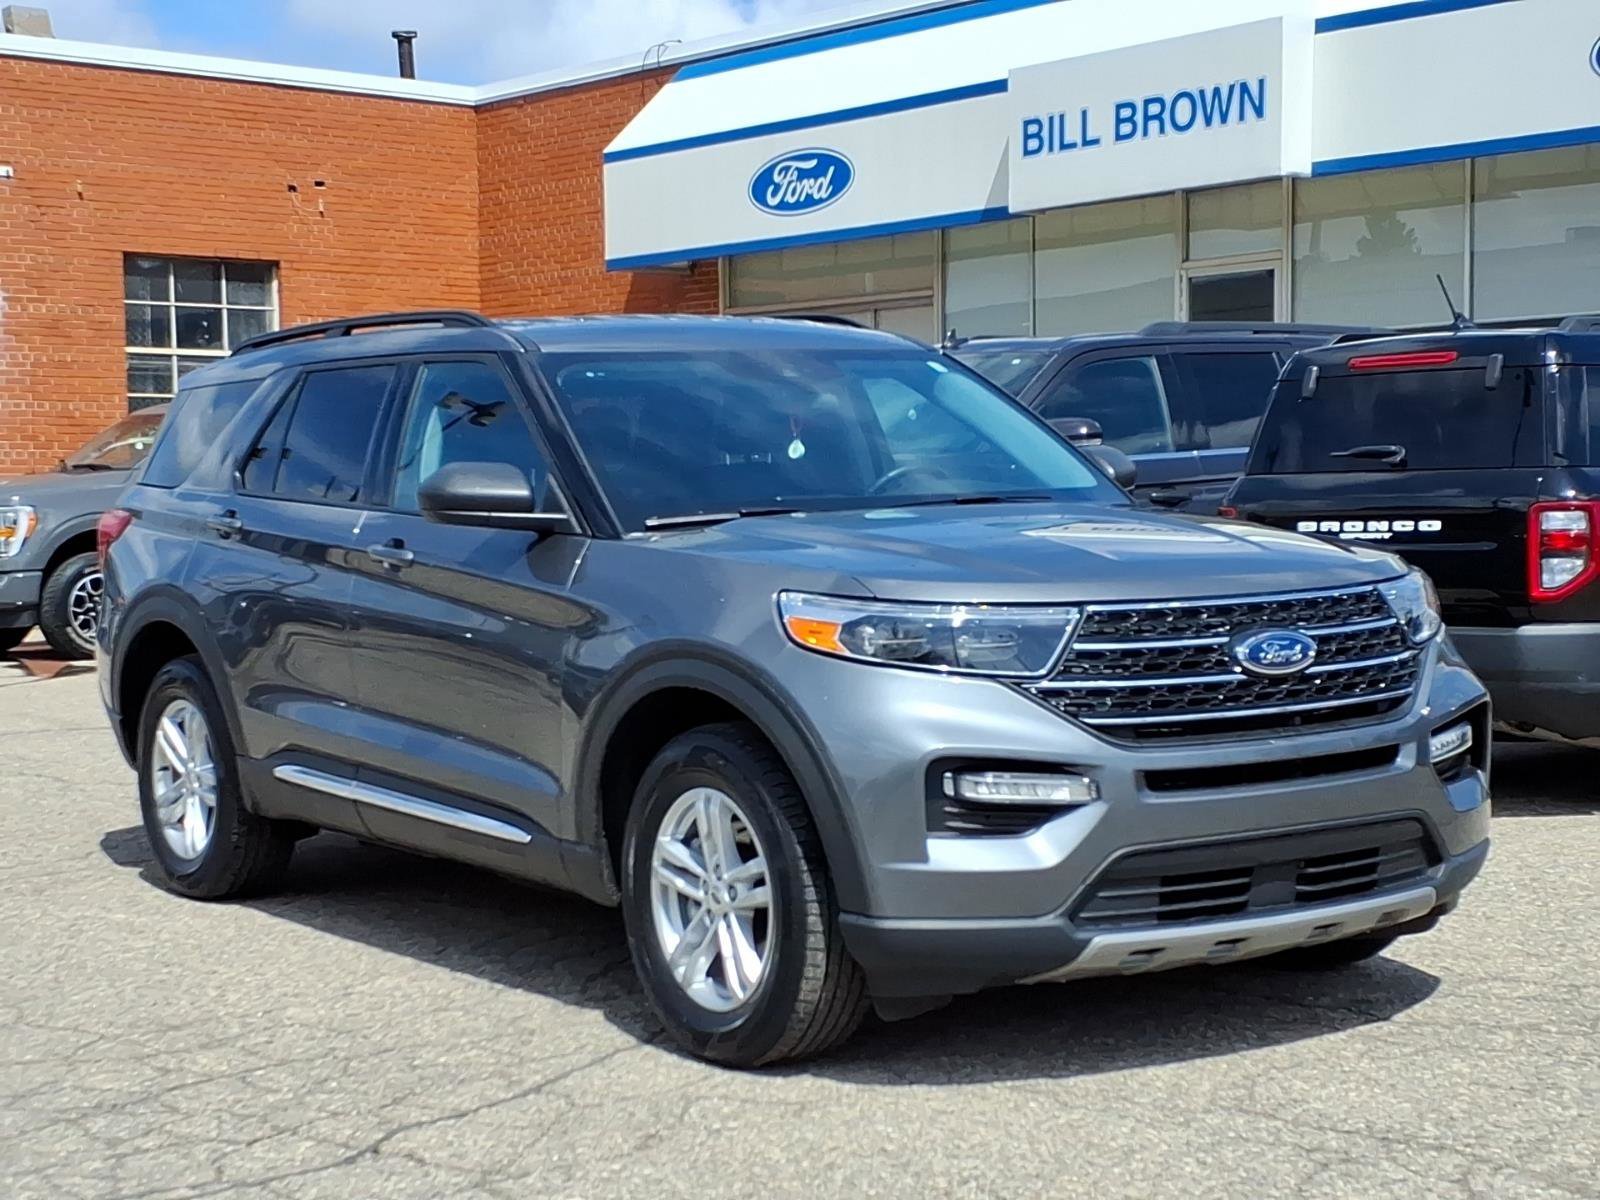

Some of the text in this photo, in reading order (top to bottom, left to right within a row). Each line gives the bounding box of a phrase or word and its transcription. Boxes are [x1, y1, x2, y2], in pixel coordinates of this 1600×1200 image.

[1022, 78, 1265, 157] BILL BROWN
[766, 158, 835, 206] Ford
[1297, 520, 1442, 533] BRONCO
[1259, 640, 1303, 664] Ford
